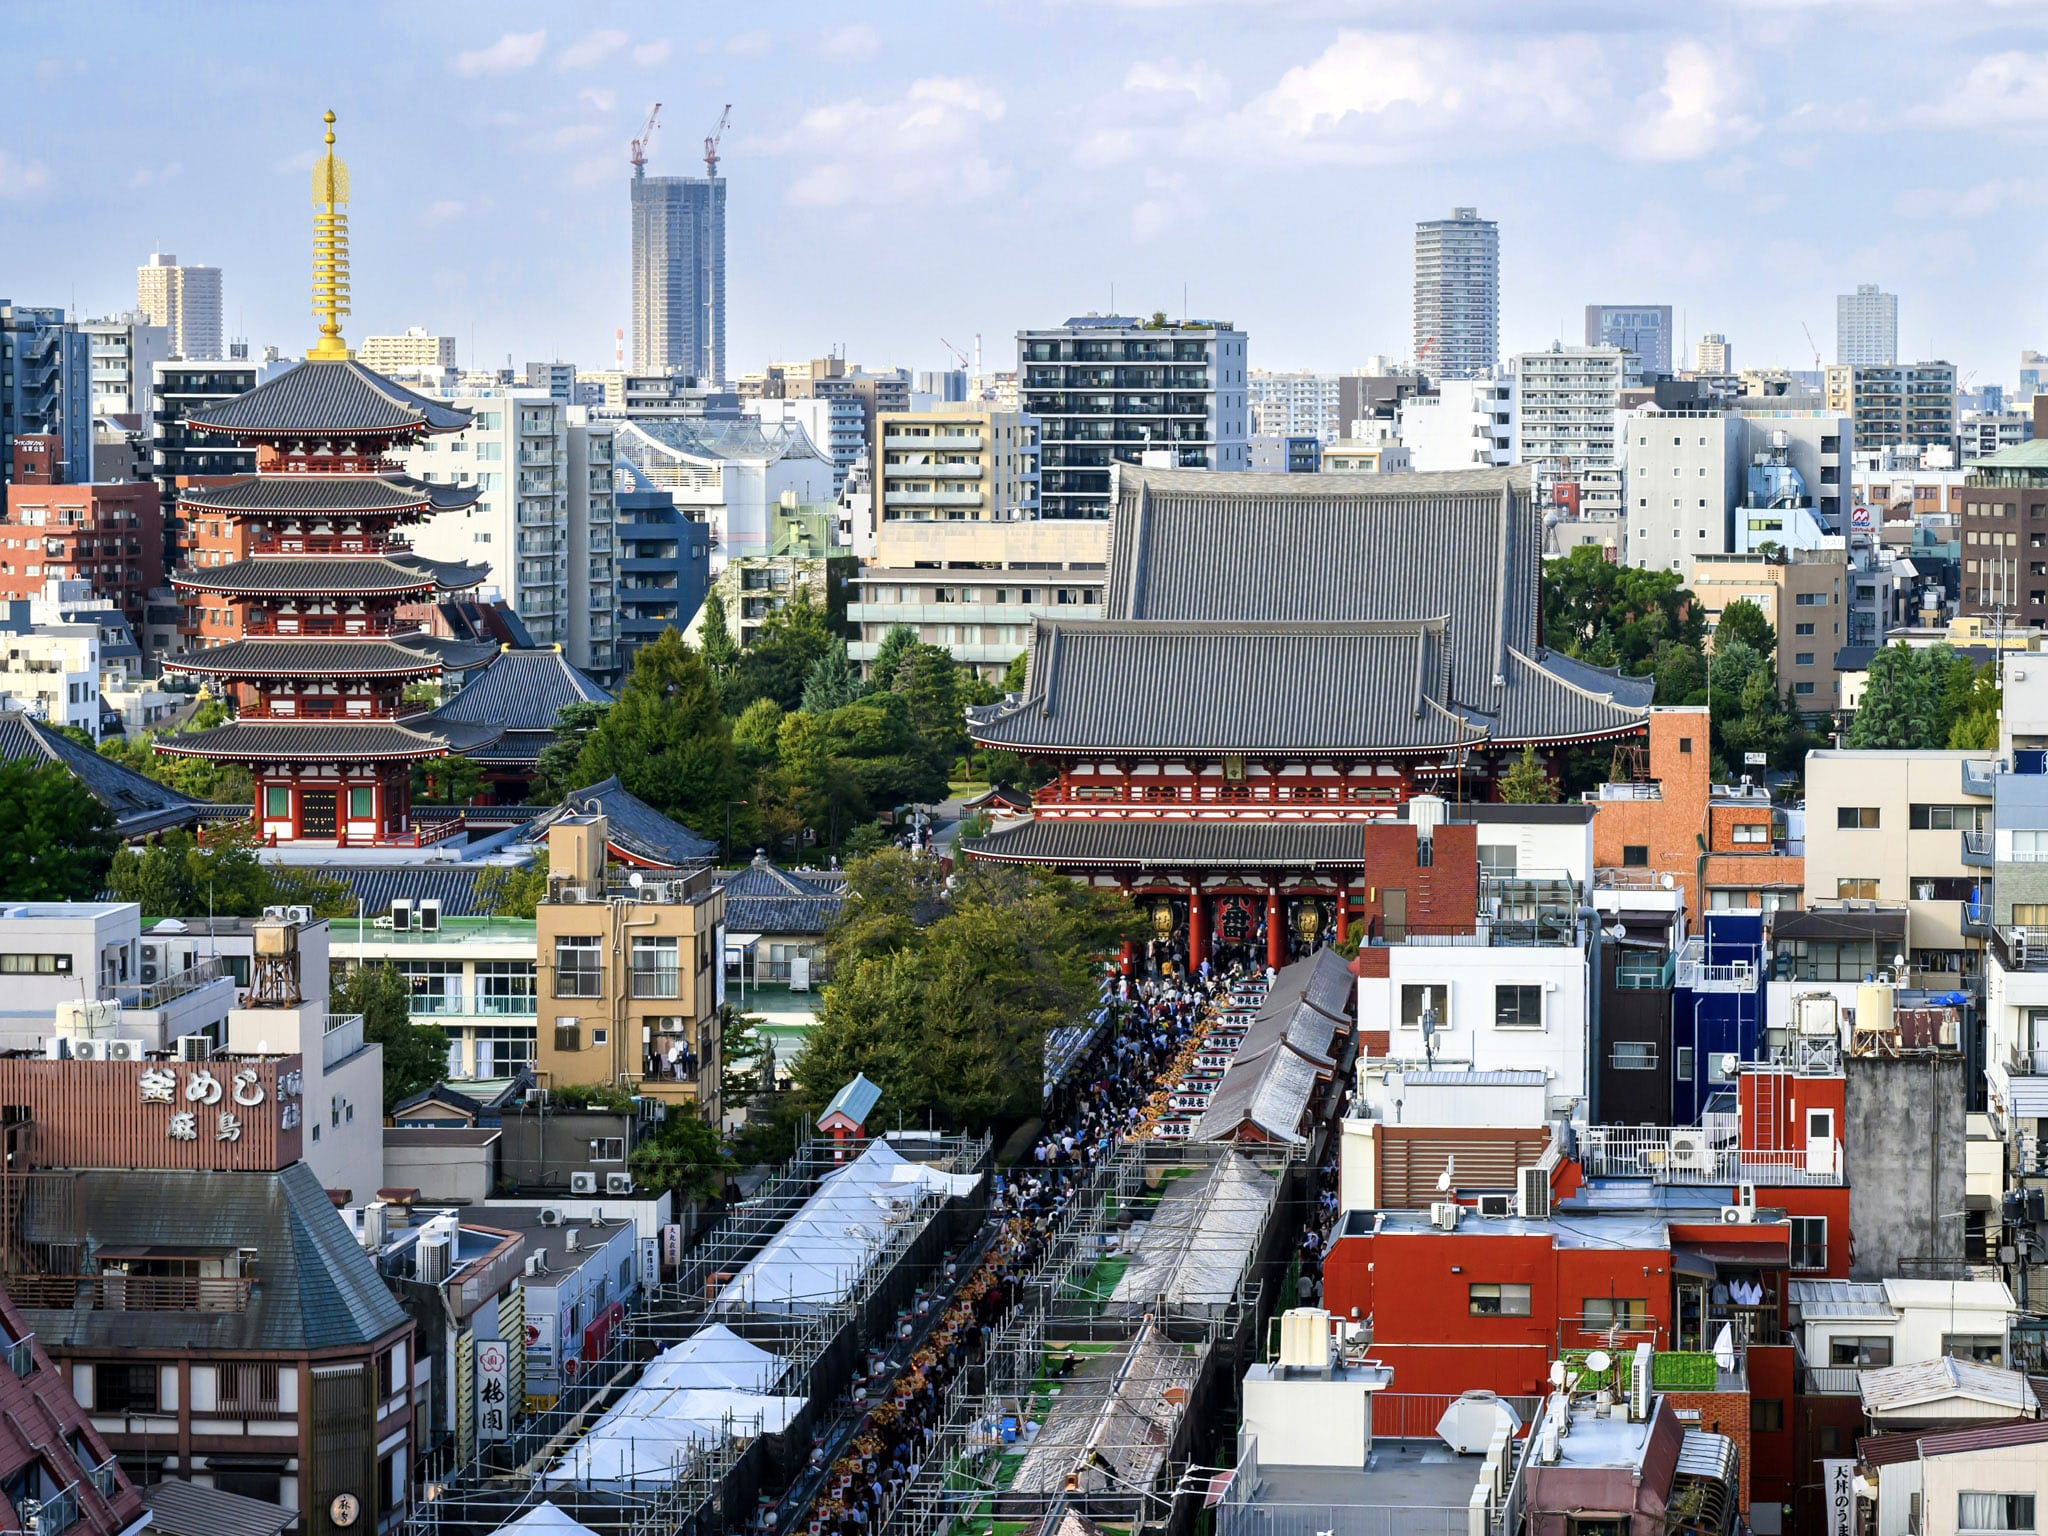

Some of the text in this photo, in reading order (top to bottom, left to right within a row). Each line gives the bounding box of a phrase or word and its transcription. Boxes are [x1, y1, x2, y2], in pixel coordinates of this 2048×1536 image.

[1222, 896, 1251, 938] 小舟町
[139, 1066, 265, 1106] 釜めし
[166, 1110, 243, 1142] 麻鳥
